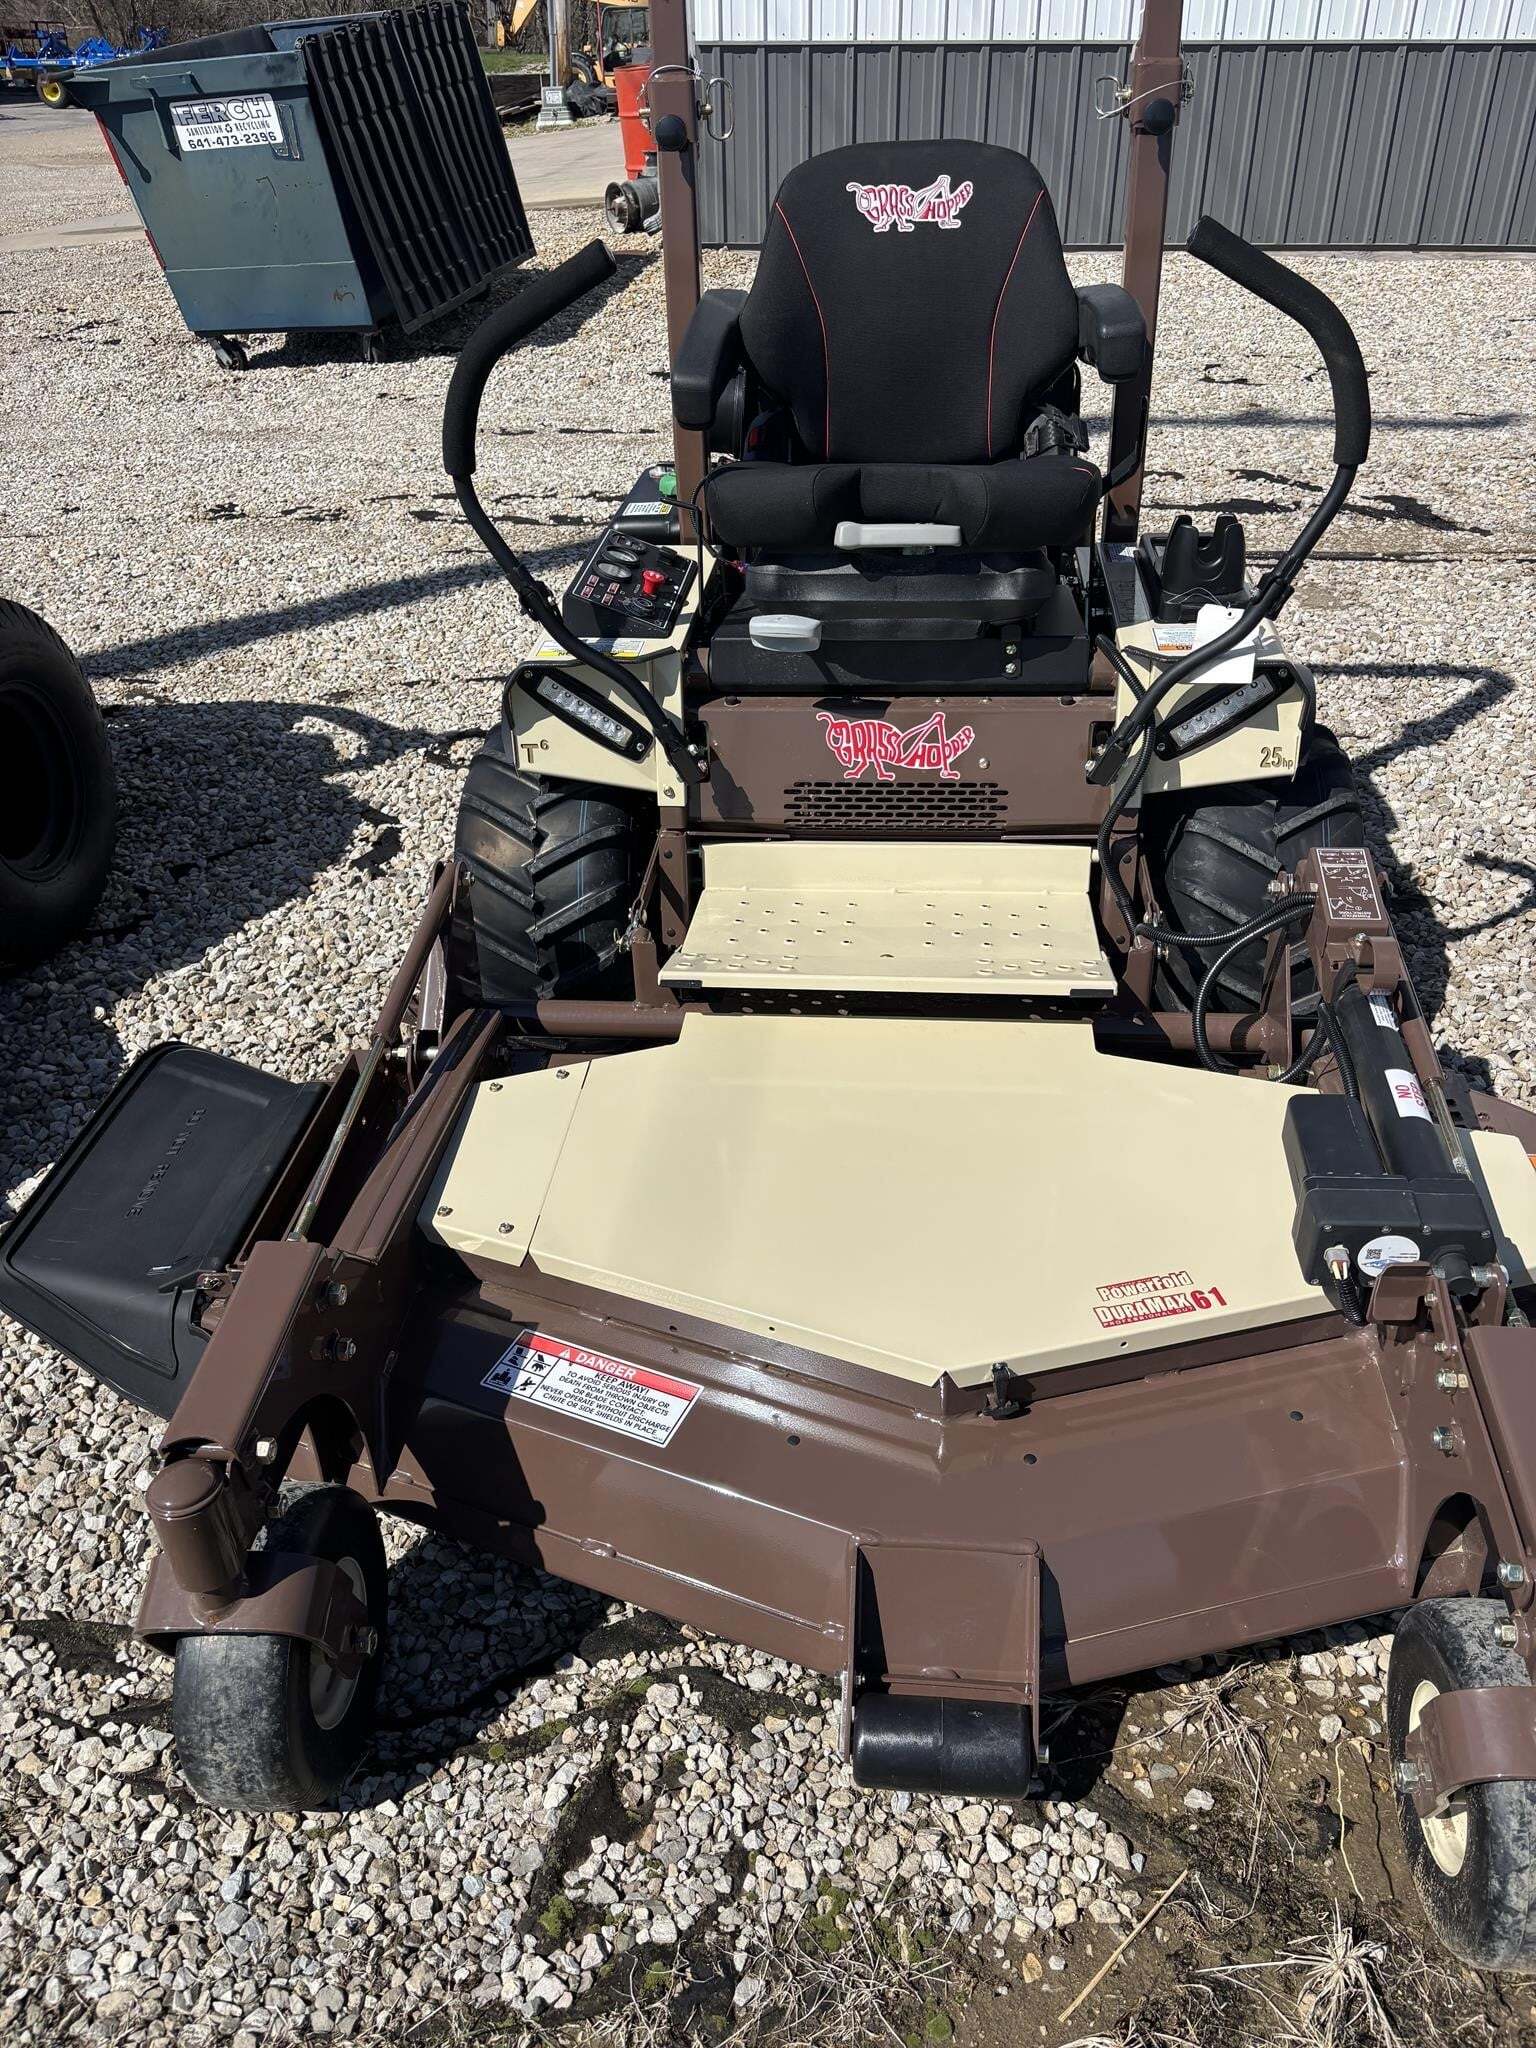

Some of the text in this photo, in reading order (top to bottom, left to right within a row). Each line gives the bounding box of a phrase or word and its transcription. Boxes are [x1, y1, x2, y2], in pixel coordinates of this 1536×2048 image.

[175, 96, 271, 126] FERCH
[186, 119, 271, 136] SANITATION RECYCLING
[188, 131, 277, 149] 641-473-2396
[1394, 1084, 1413, 1099] NO
[1190, 1286, 1227, 1310] 61
[575, 1353, 637, 1380] DANGER
[559, 1375, 669, 1416] DEATH FROM THROWN OBJECTS
[568, 1370, 578, 1378] TO
[578, 1375, 601, 1386] AVOID
[602, 1382, 631, 1397] SERIOUS
[632, 1392, 658, 1405] INJURY
[573, 1387, 585, 1395] OR
[585, 1391, 608, 1403] BLADE
[595, 1373, 650, 1396] KEEP AWAY!
[540, 1384, 671, 1432] NEVER OPERATE WITHOUT DISCHARGE
[543, 1392, 566, 1404] CHUTE
[567, 1400, 579, 1408] OR
[578, 1405, 595, 1414] SIDE
[595, 1410, 624, 1424] SHIELDS
